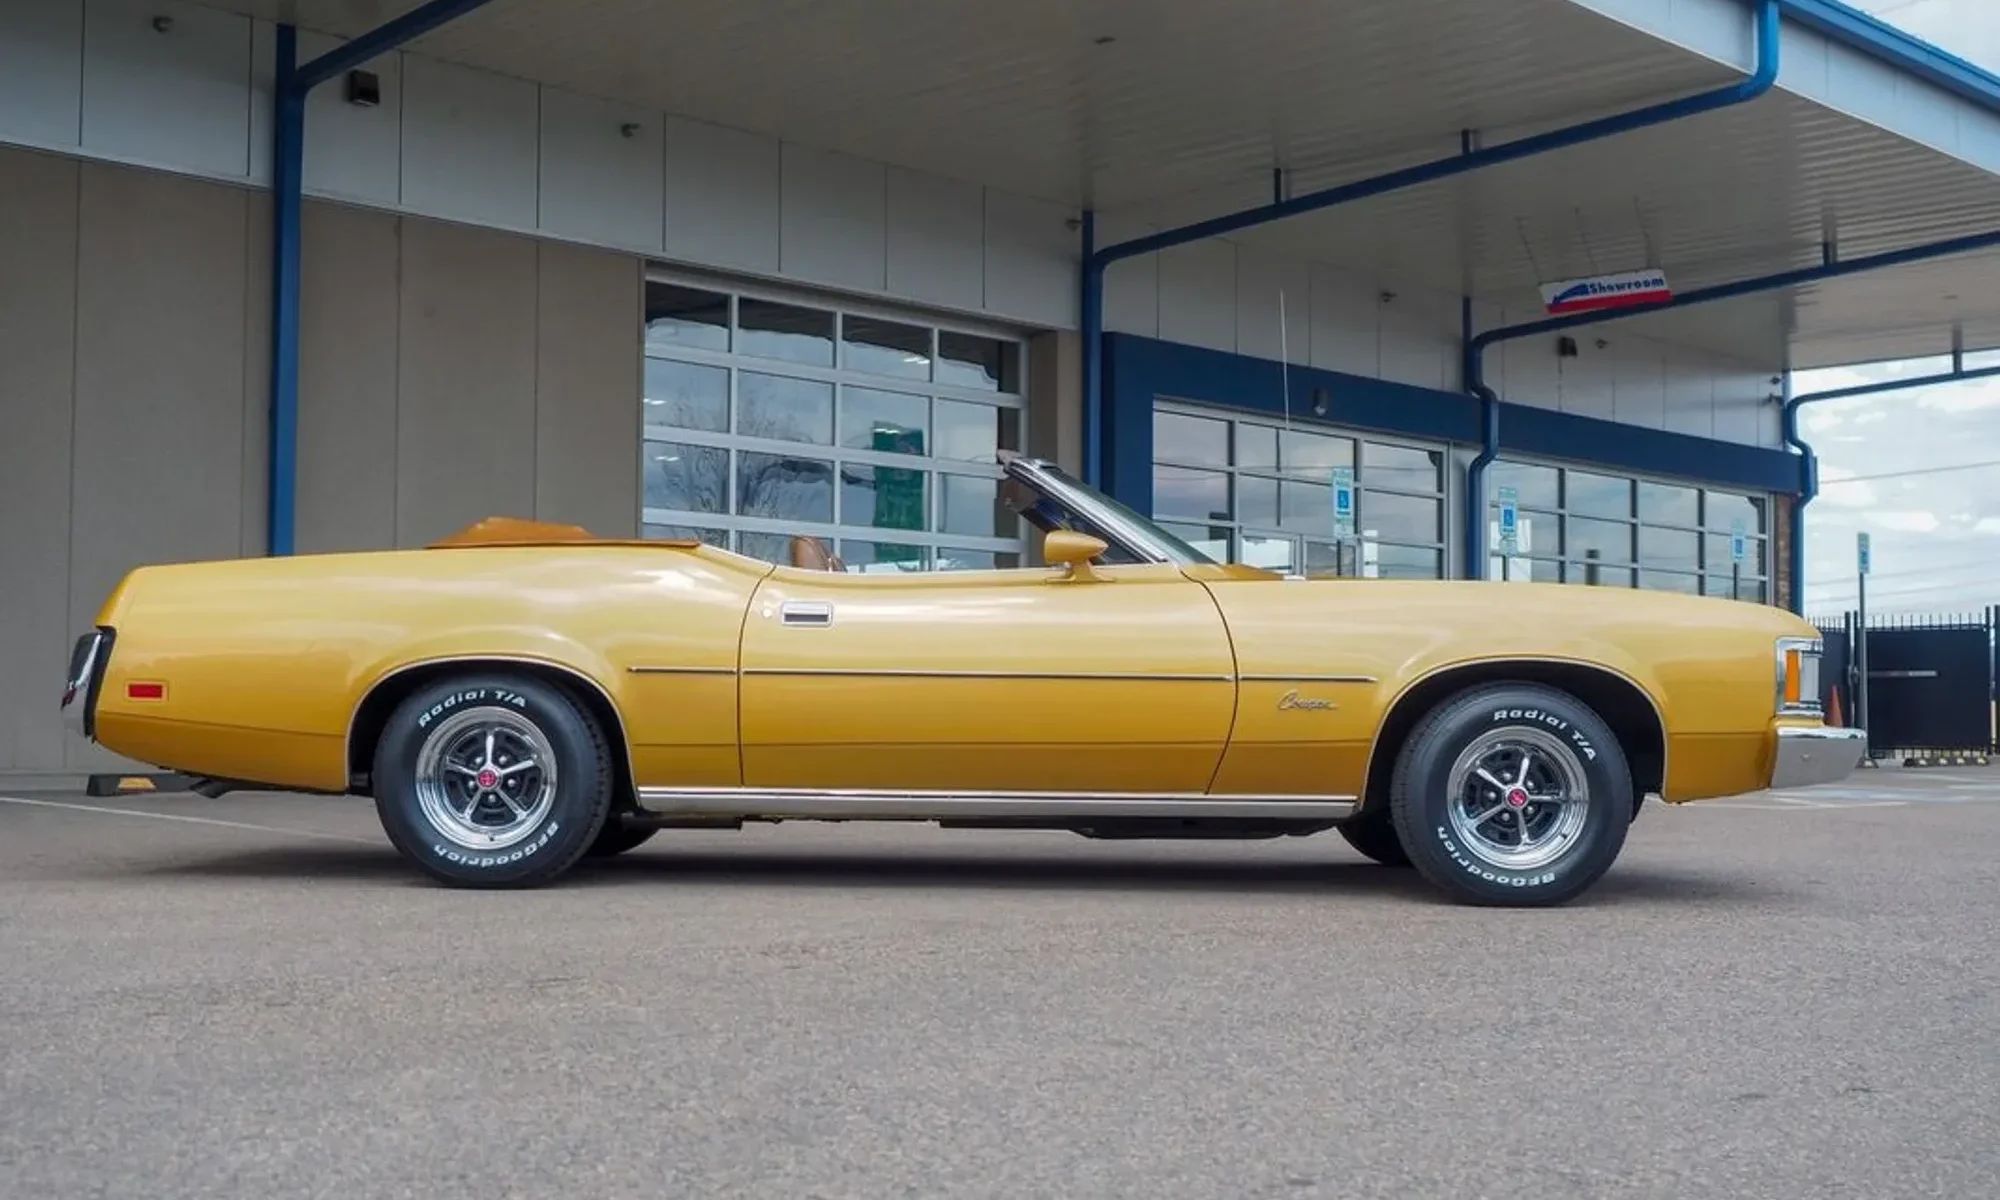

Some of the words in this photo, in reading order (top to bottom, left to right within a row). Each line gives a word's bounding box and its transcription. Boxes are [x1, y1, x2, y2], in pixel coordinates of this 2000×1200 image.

[1589, 277, 1664, 294] Showroom
[418, 689, 485, 728] Radial
[494, 690, 527, 708] T/A
[1493, 709, 1568, 730] Radial
[1572, 729, 1597, 761] T/A
[433, 821, 560, 867] BFGoodrich
